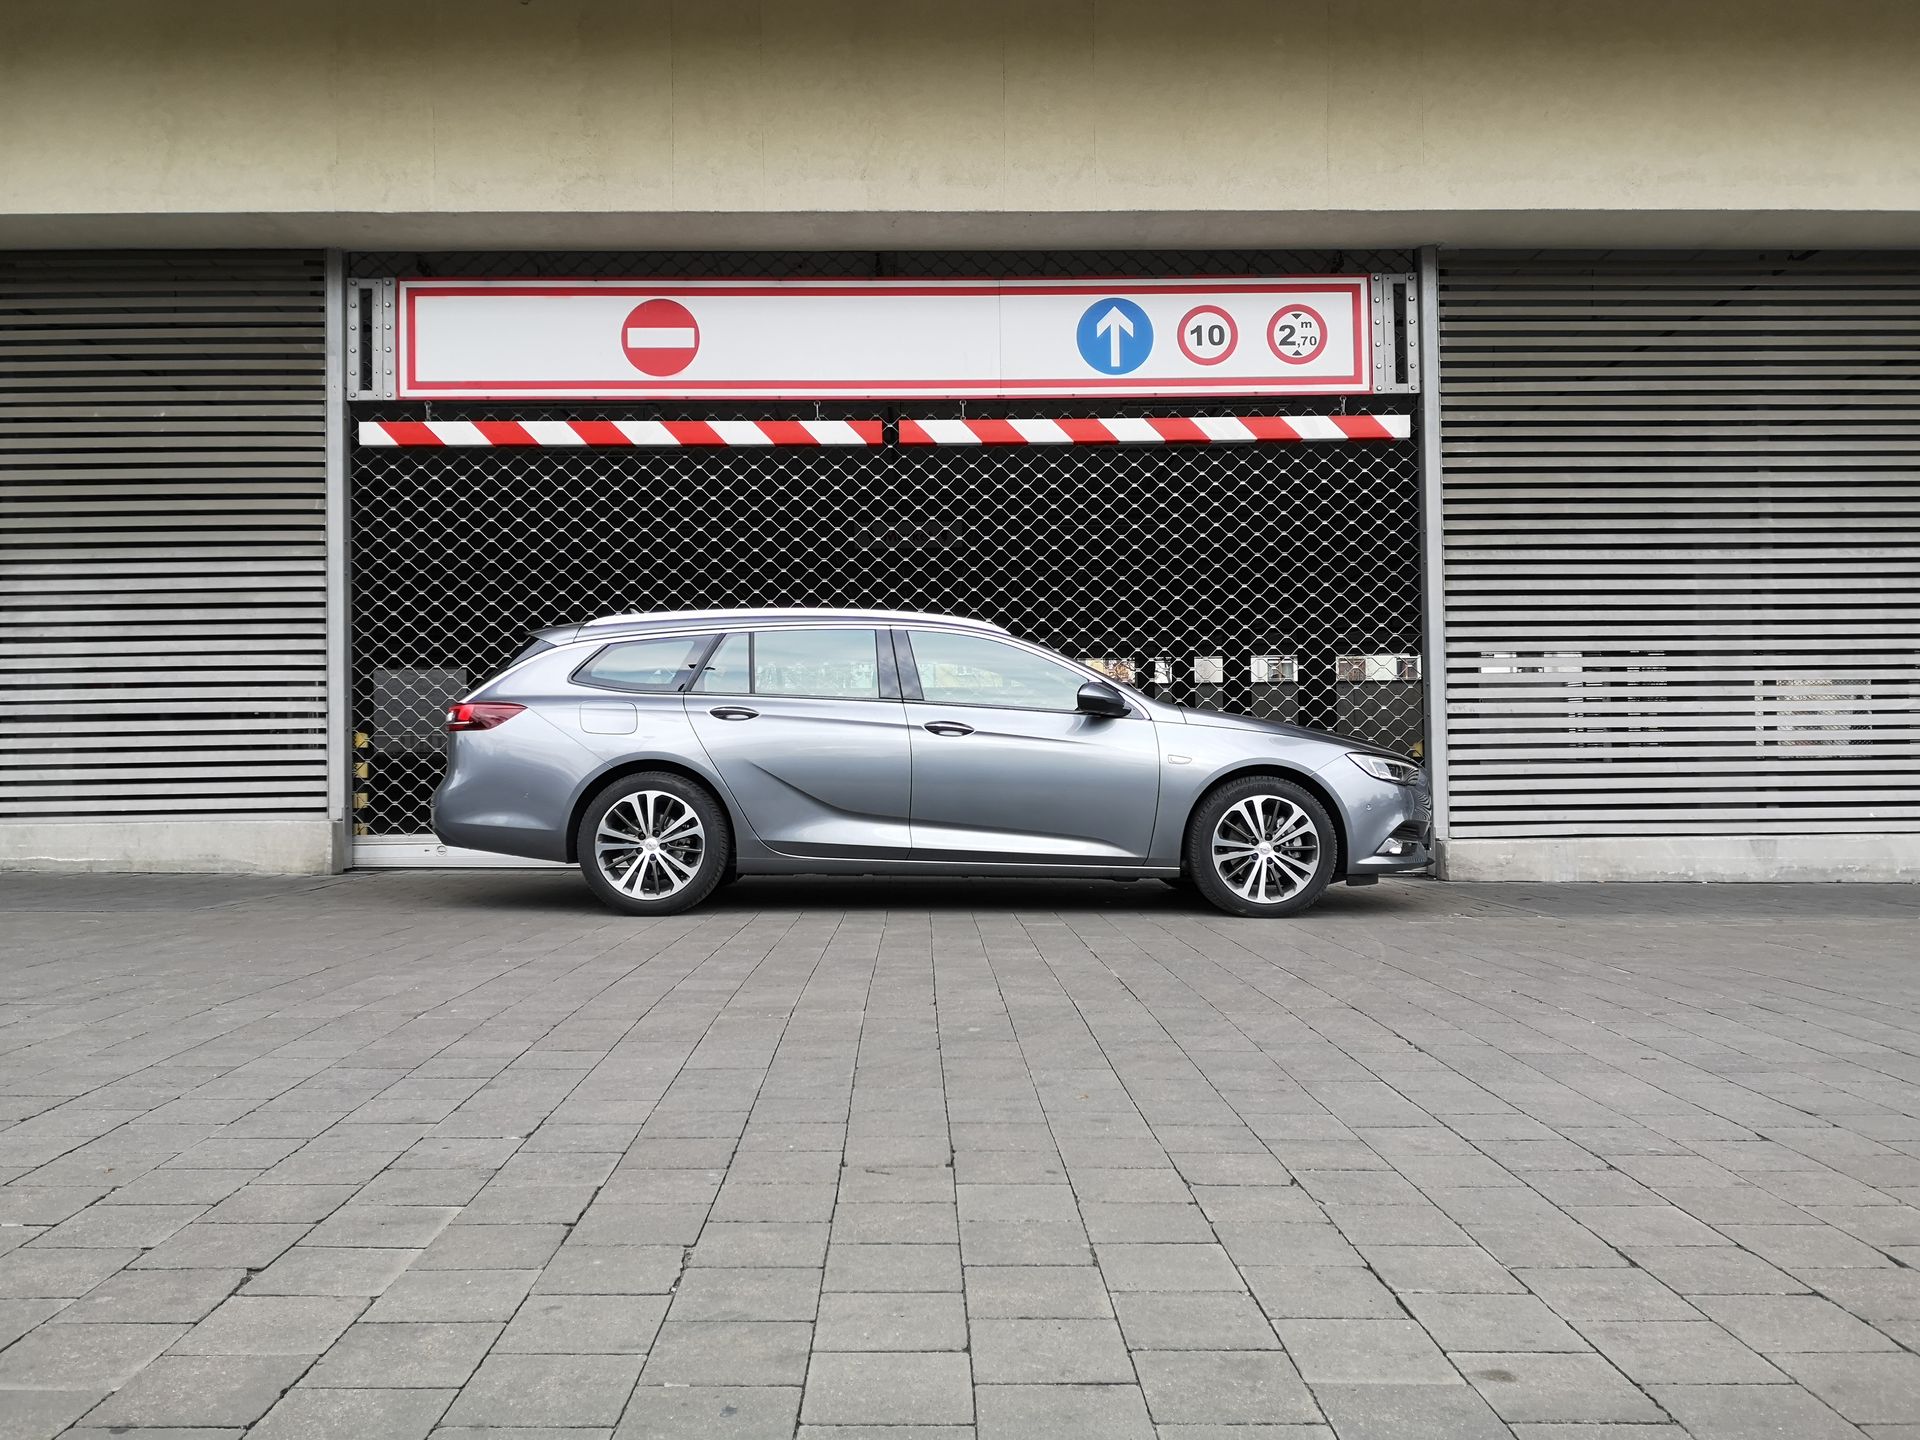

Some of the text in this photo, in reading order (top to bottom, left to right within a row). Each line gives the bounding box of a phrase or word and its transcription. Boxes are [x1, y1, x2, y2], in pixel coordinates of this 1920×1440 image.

[1190, 324, 1225, 346] 10
[1278, 324, 1317, 348] 2,70
[1300, 321, 1312, 329] m
